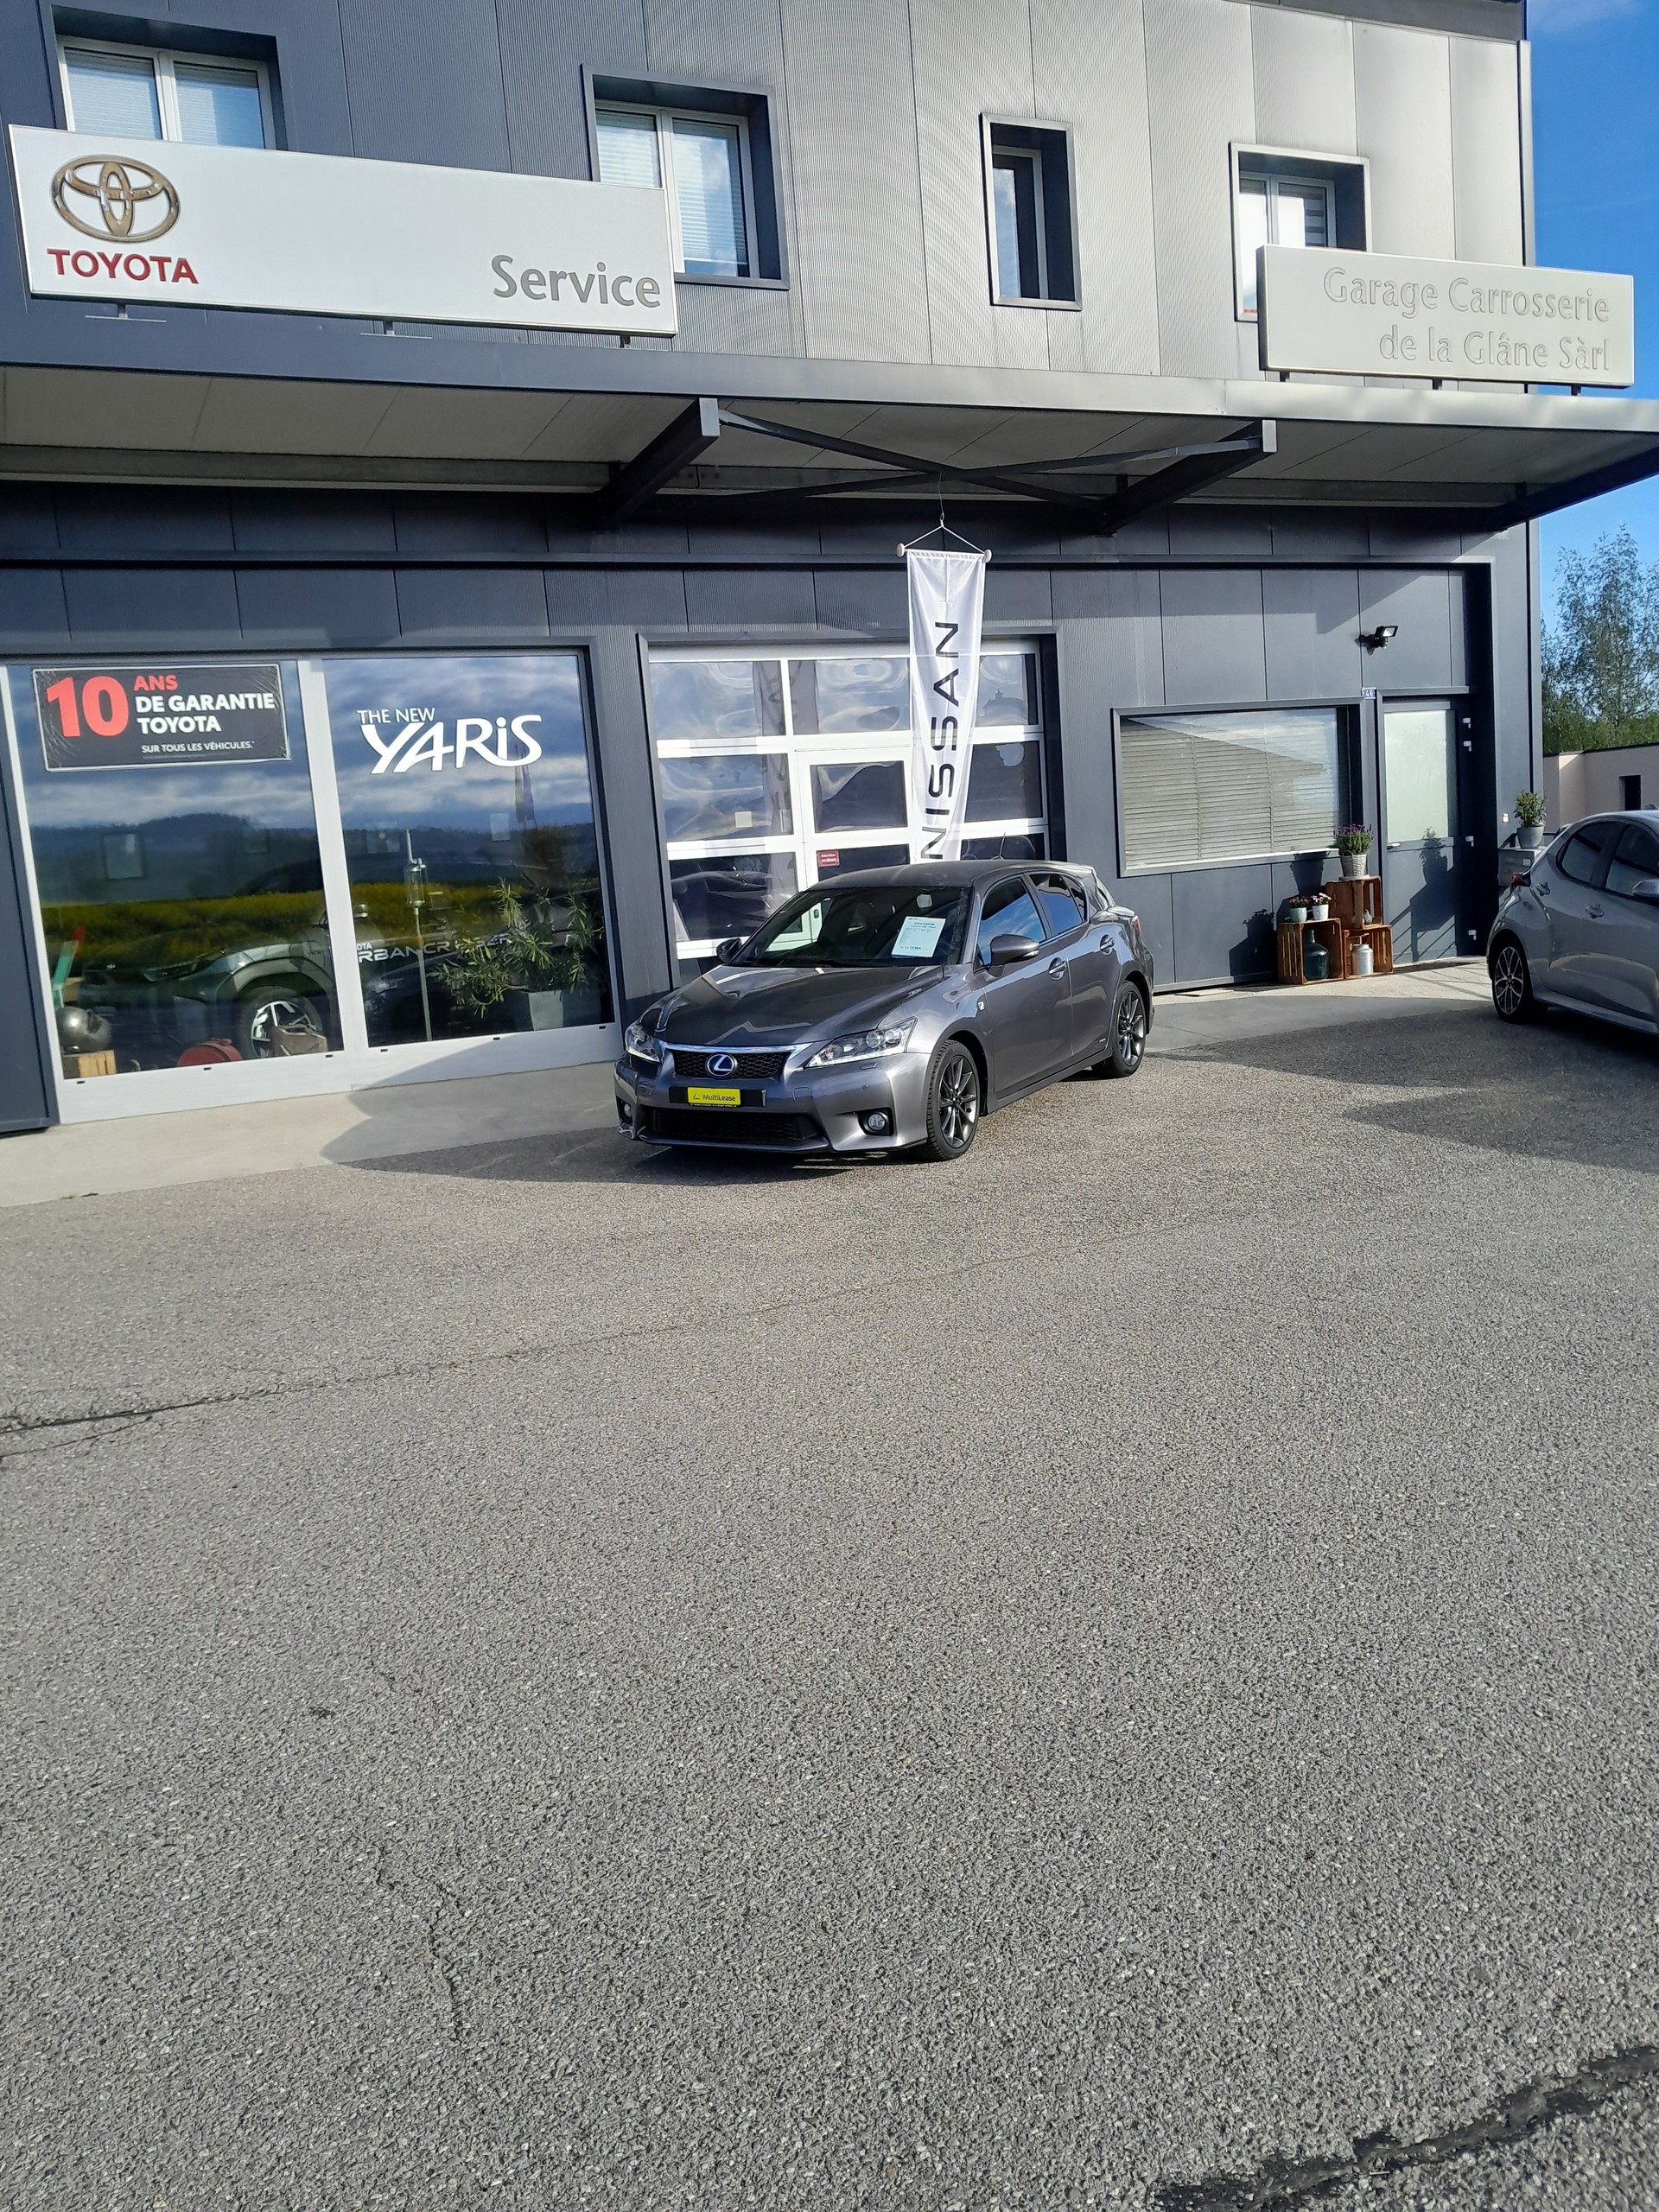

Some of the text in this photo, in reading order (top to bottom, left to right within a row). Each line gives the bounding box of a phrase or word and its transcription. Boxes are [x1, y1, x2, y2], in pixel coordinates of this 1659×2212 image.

[47, 247, 200, 285] TOYOTA
[491, 254, 662, 308] Service
[1323, 266, 1611, 323] Garage Carrosserie
[1379, 324, 1611, 372] de la Glâne Sàrl
[133, 674, 179, 692] ANS
[1365, 689, 1374, 697] 46
[46, 676, 130, 738] 10
[135, 692, 276, 714] DE GARANTIE
[137, 715, 222, 734] TOYOTA
[356, 707, 435, 724] THE NEW
[141, 744, 161, 753] SUR
[161, 743, 187, 753] TOUS
[188, 742, 203, 752] LES
[920, 621, 960, 860] NISSAN
[358, 946, 418, 963] RBAN
